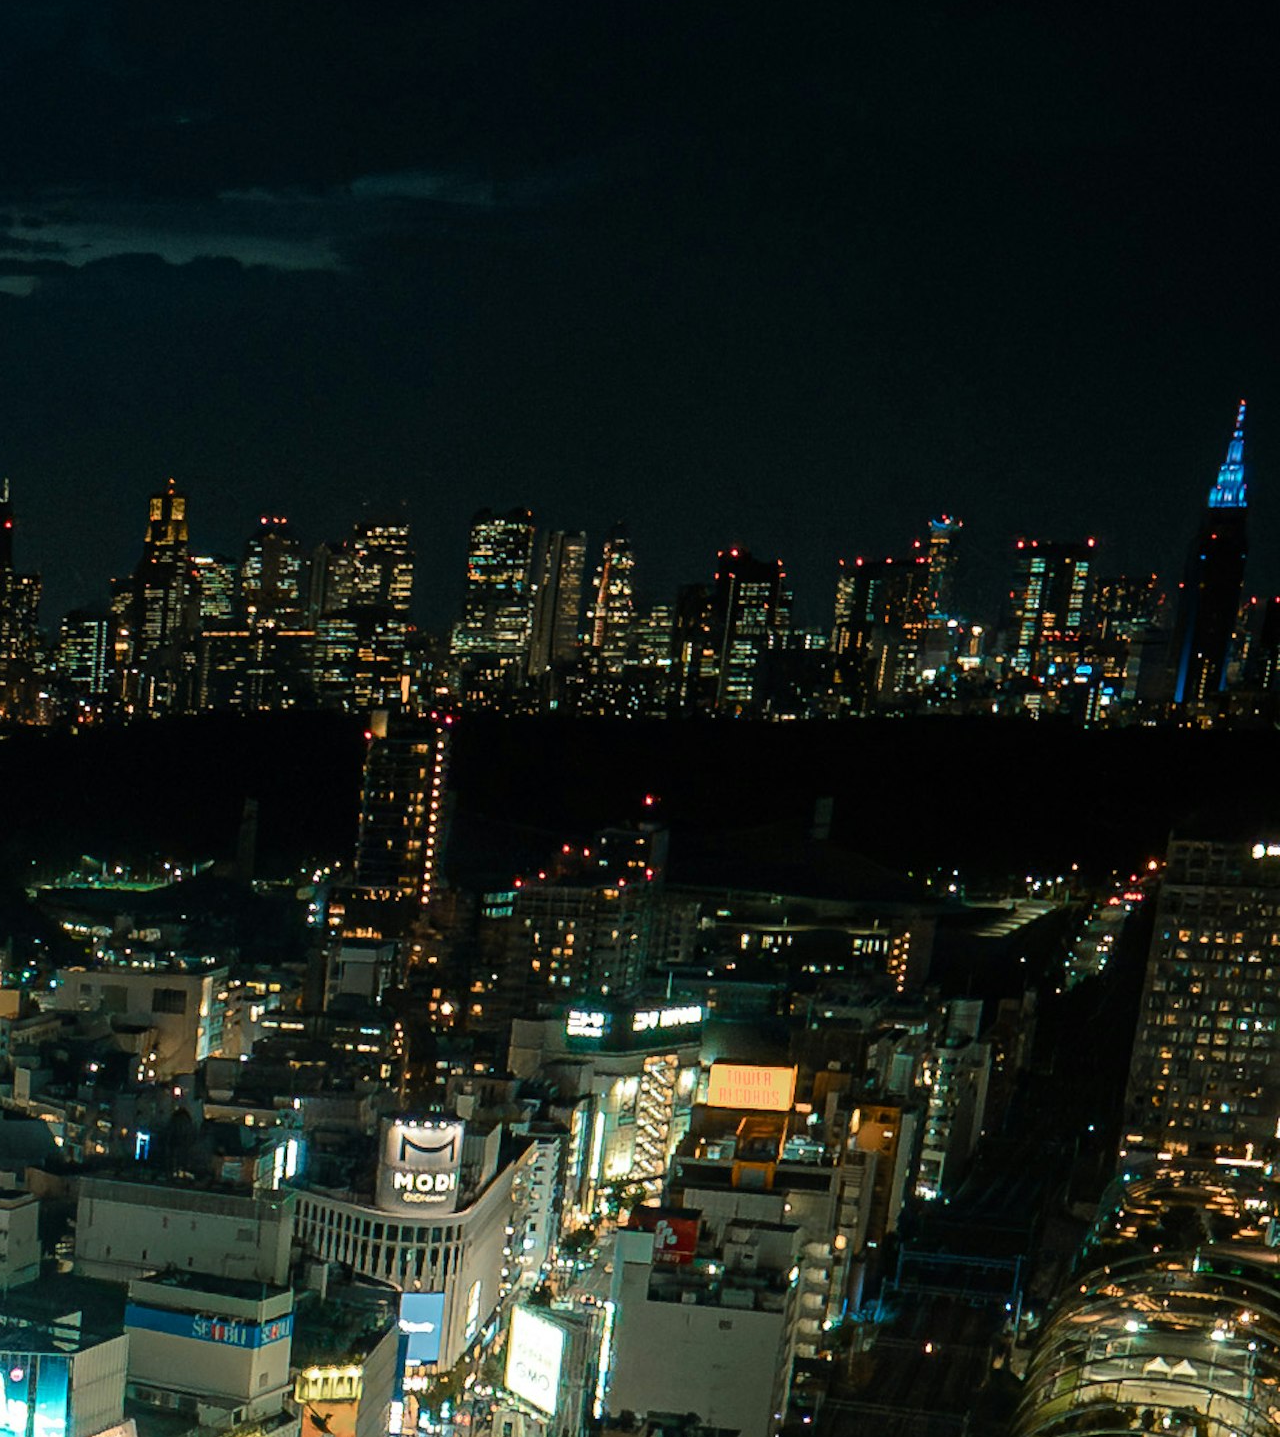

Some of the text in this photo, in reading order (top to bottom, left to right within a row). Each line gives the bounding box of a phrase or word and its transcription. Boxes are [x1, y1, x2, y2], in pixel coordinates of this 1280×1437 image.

[727, 1069, 772, 1087] TOWER
[719, 1088, 780, 1106] RECORDS
[393, 1172, 456, 1192] MODI
[192, 1319, 247, 1345] SEIBU
